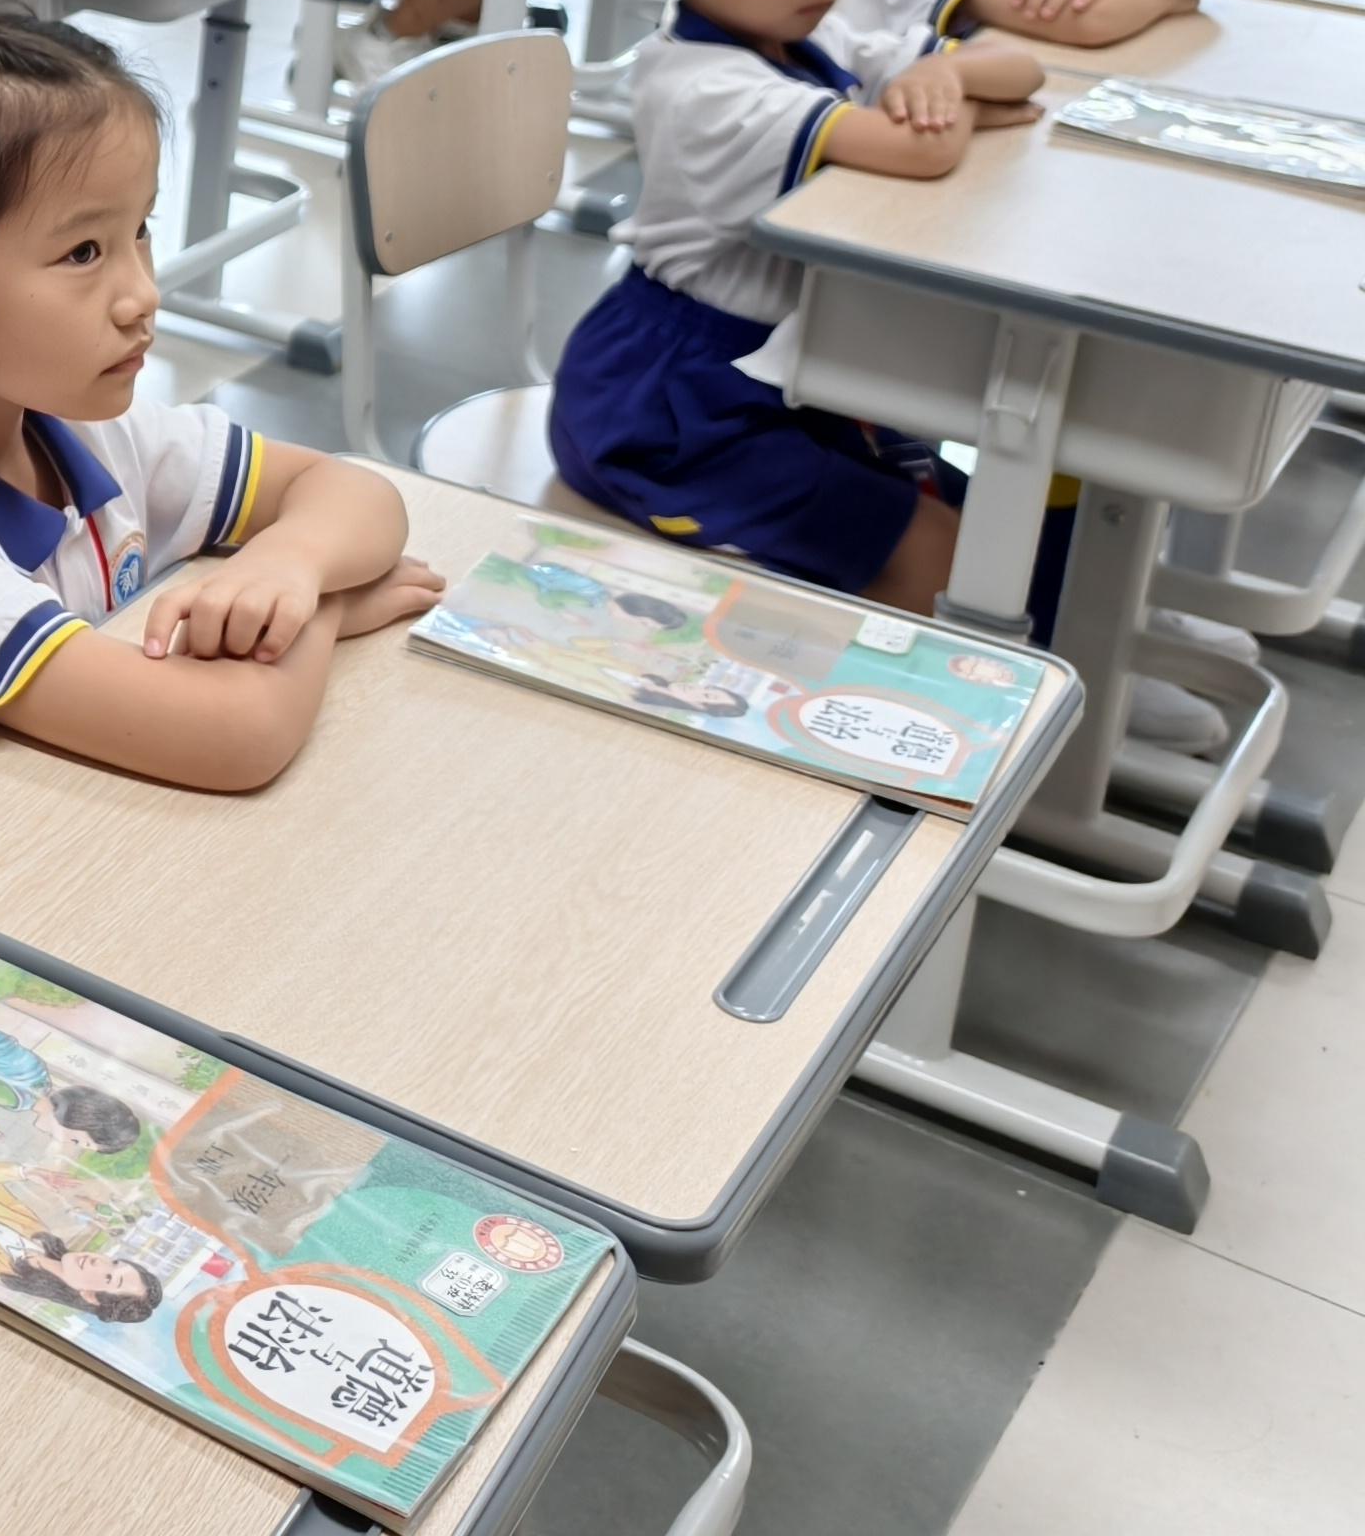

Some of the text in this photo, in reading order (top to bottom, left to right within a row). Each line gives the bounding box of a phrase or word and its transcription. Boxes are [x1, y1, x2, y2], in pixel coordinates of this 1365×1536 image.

[227, 1290, 334, 1373] 法治
[309, 1342, 356, 1372] 与
[330, 1337, 436, 1428] 道德
